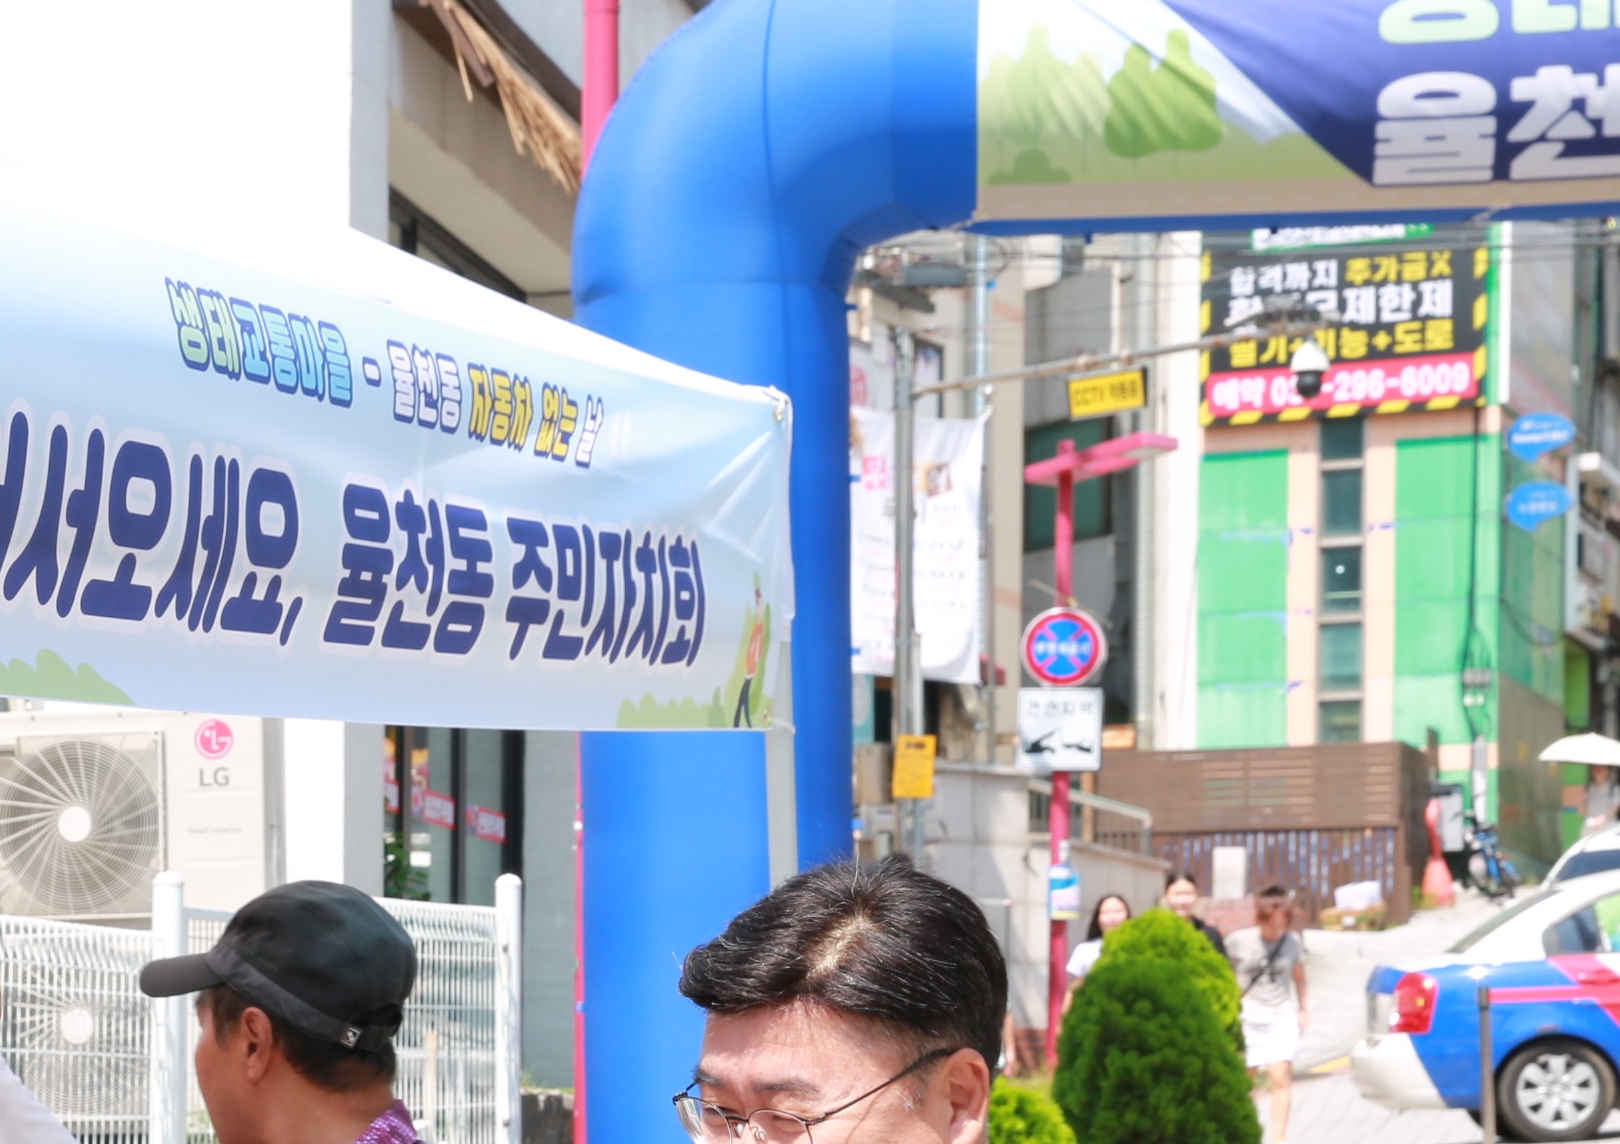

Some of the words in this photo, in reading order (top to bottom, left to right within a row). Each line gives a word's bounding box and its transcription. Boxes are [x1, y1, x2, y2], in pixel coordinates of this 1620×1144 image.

[164, 277, 354, 409] 생태교통마을
[386, 339, 463, 434] 율천동
[467, 362, 534, 453] 자동차
[534, 382, 578, 464] 없는
[575, 394, 605, 468] 날
[322, 482, 496, 656] 율천동
[502, 514, 707, 669] 주민자치회
[198, 766, 231, 787] LG
